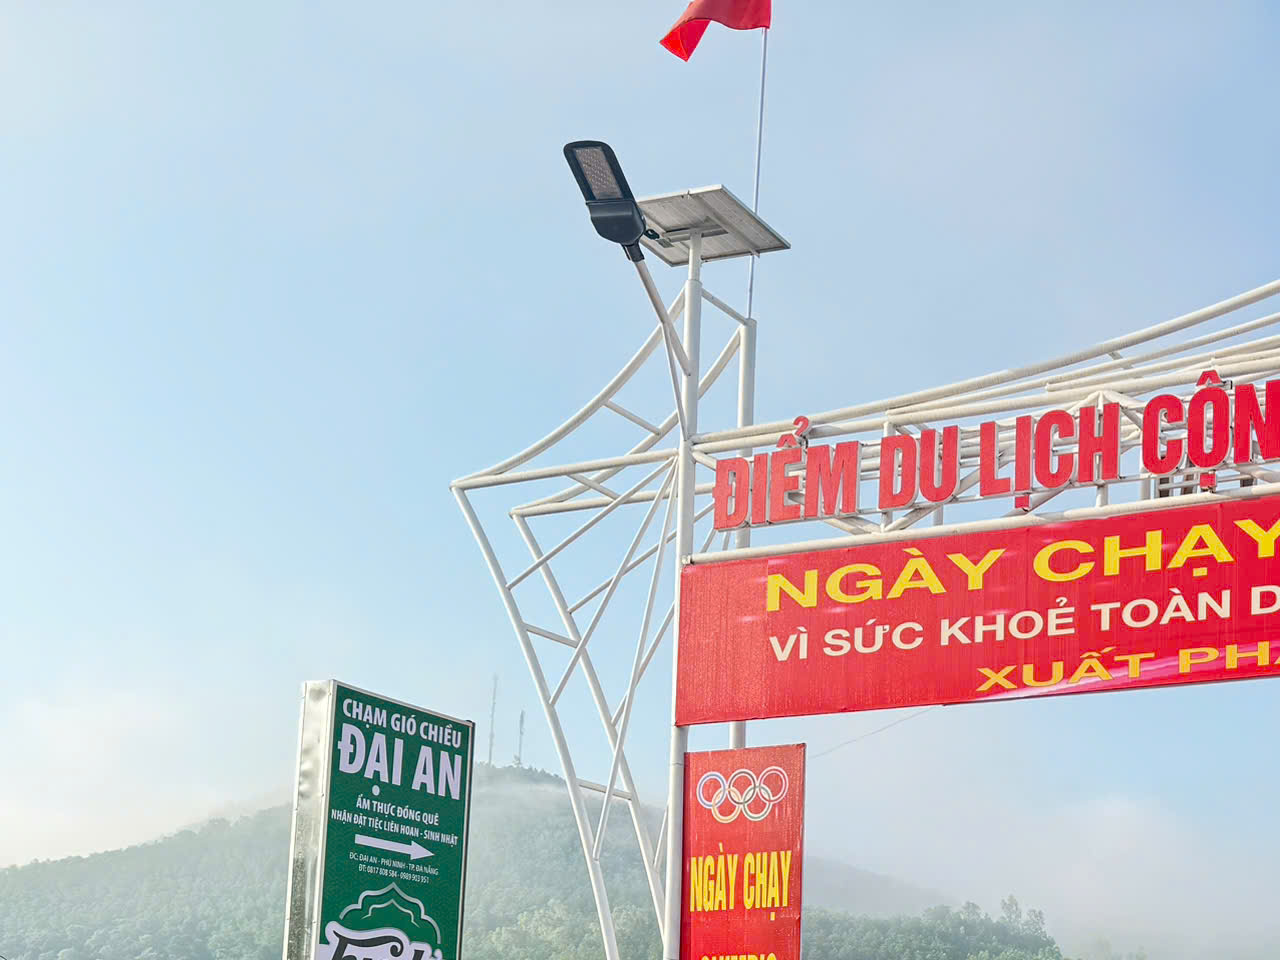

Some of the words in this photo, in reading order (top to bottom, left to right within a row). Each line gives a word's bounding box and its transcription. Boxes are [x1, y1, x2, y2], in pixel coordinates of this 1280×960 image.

[712, 415, 861, 532] ĐIỂM
[878, 425, 959, 511] DU
[979, 400, 1122, 512] LỊCH
[765, 547, 1007, 613] NGÀY
[769, 624, 809, 664] VÌ
[822, 619, 924, 659] SỨC
[940, 596, 1076, 647] KHOẺ
[1091, 583, 1231, 631] TOÀN
[975, 648, 1143, 692] XUẤT
[342, 698, 387, 729] CHẠM
[390, 714, 417, 736] GIÓ
[419, 723, 462, 749] CHIỀU
[338, 722, 404, 797] ĐẠI
[411, 745, 462, 800] AN
[331, 809, 352, 825] NHẬN
[368, 817, 383, 832] TIỆC
[383, 820, 399, 833] LIÊN
[400, 824, 419, 838] HOAN
[423, 830, 440, 842] SINH
[440, 834, 458, 848] NHẬT
[372, 800, 396, 818] THỰC
[422, 811, 439, 826] QUÊ
[369, 856, 378, 864] AN
[689, 842, 738, 912] NGÀY
[744, 850, 792, 921] CHẠY
